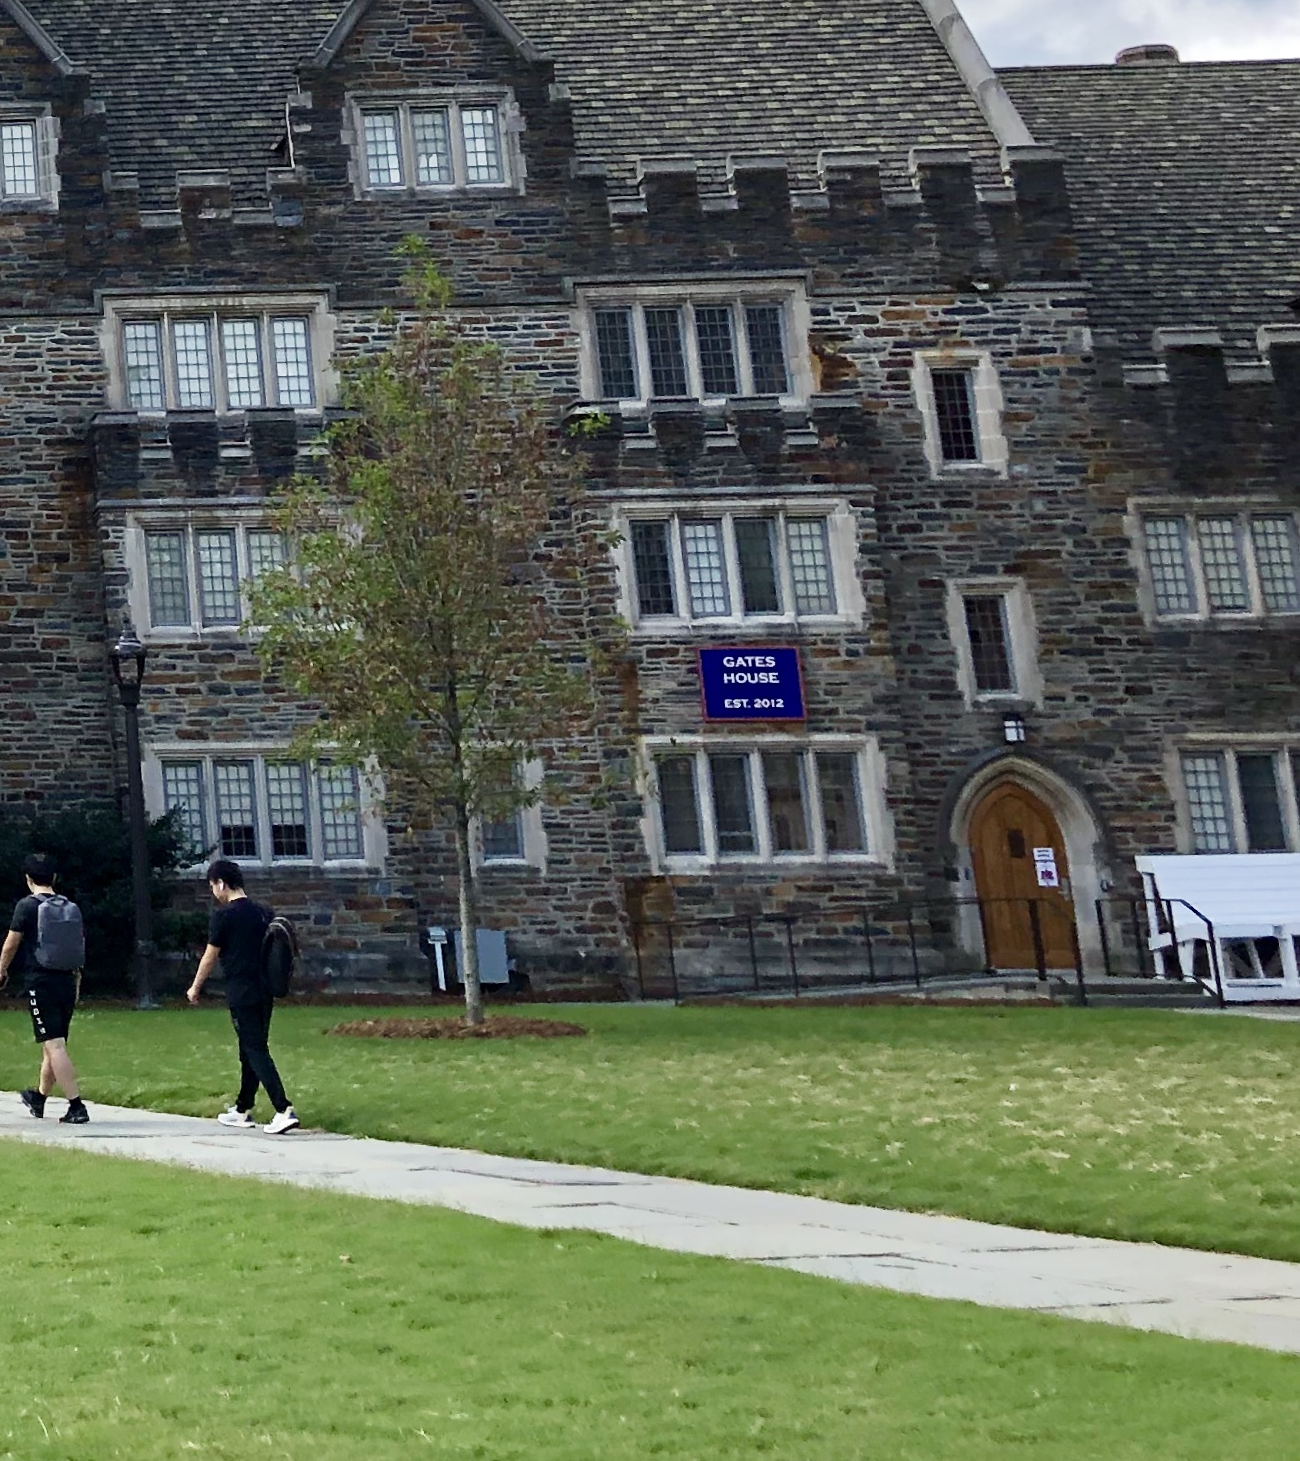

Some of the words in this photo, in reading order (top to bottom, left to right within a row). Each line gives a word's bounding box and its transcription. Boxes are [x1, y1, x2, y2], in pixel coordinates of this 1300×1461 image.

[723, 656, 776, 668] GATES
[723, 672, 780, 684] HOUSE
[724, 698, 751, 709] EST.
[753, 698, 785, 709] 2012
